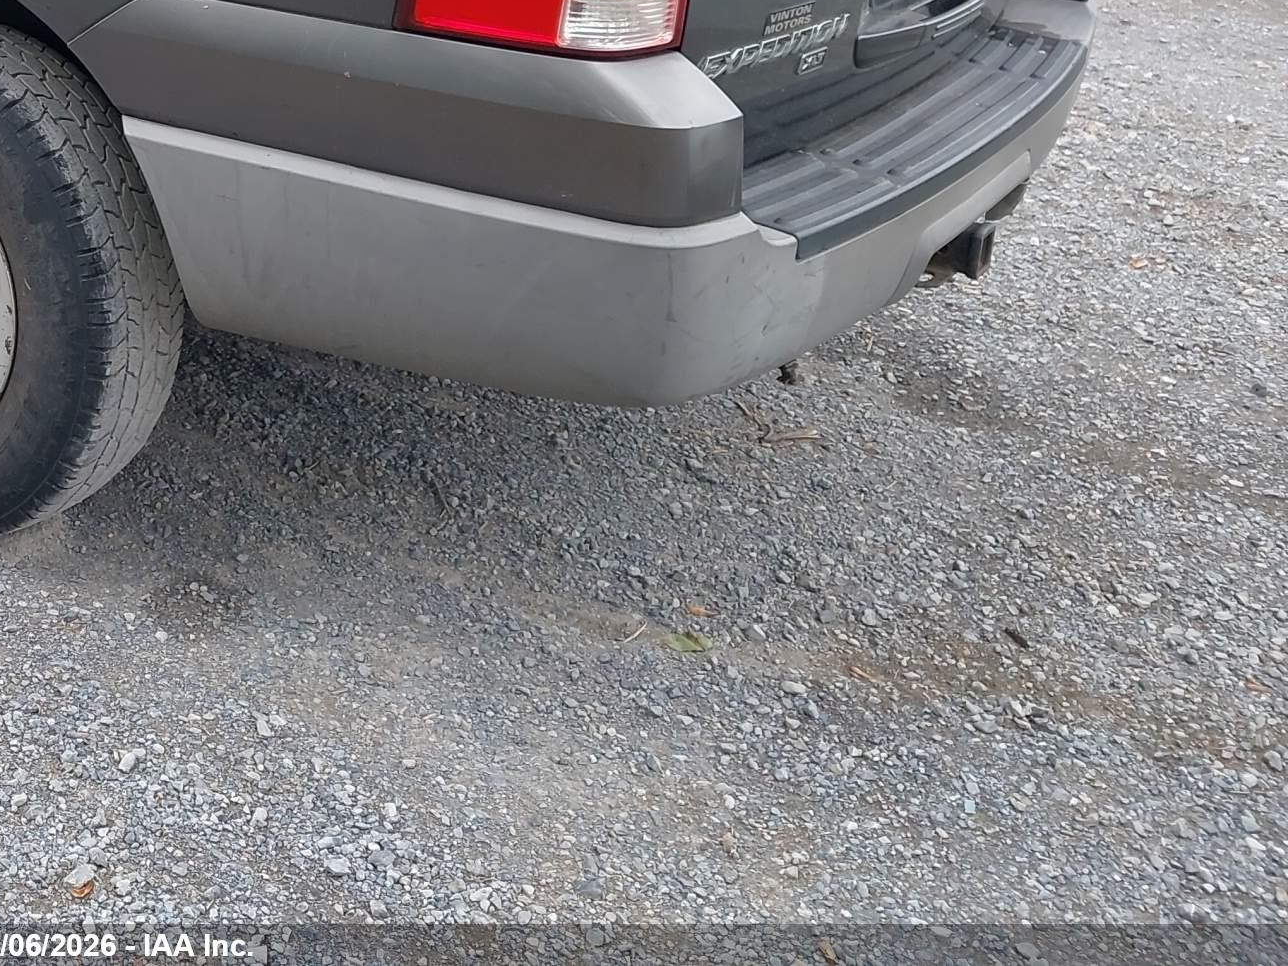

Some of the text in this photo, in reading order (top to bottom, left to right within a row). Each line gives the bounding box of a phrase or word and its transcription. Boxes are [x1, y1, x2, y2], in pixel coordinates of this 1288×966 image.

[770, 4, 812, 24] VINTON
[764, 14, 812, 36] MOTORS
[703, 13, 851, 80] EXPEDITION
[802, 52, 826, 71] XLT
